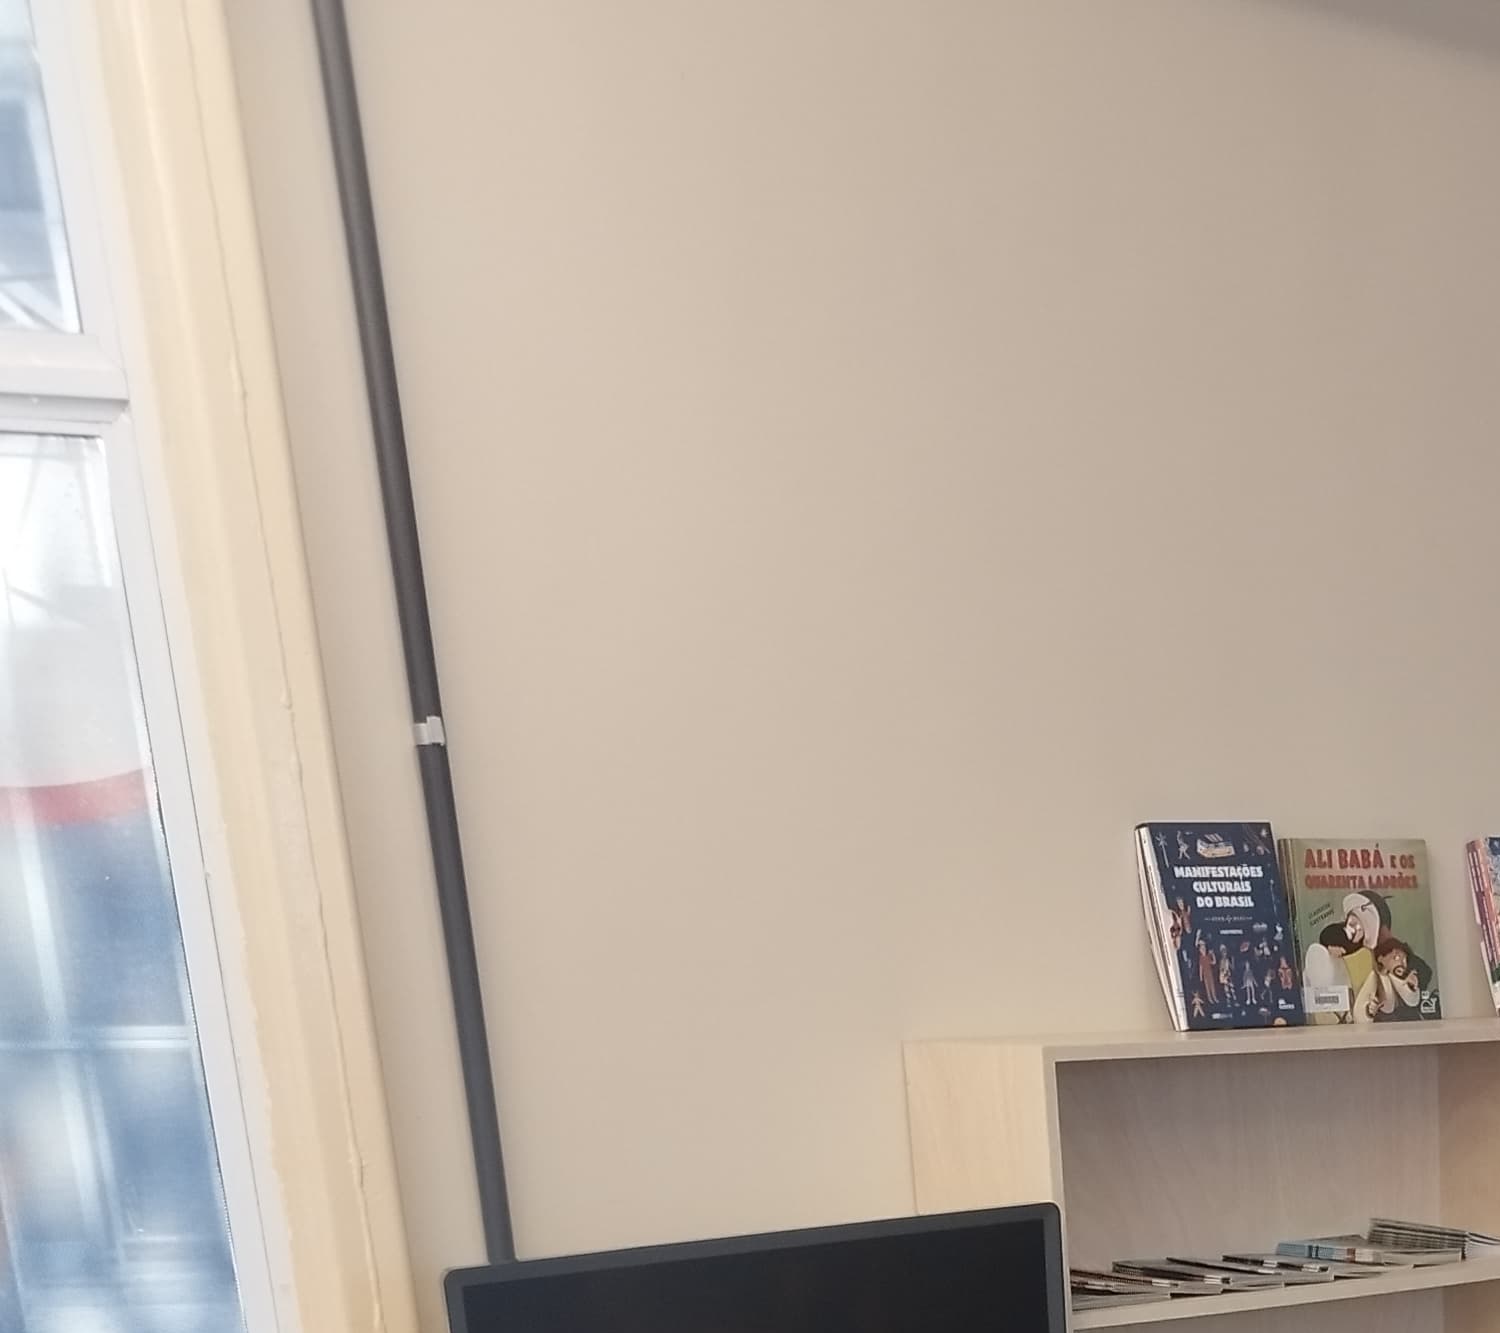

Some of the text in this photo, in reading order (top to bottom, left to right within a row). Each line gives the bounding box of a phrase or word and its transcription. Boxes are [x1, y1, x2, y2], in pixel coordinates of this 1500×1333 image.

[1304, 849, 1333, 869] ALI
[1338, 843, 1384, 869] BABÁ
[1399, 854, 1416, 869] OS
[1174, 864, 1263, 881] MANIFESTAÇÕES
[1193, 881, 1252, 893] CULTURAIS
[1196, 896, 1254, 908] DO BRASIL
